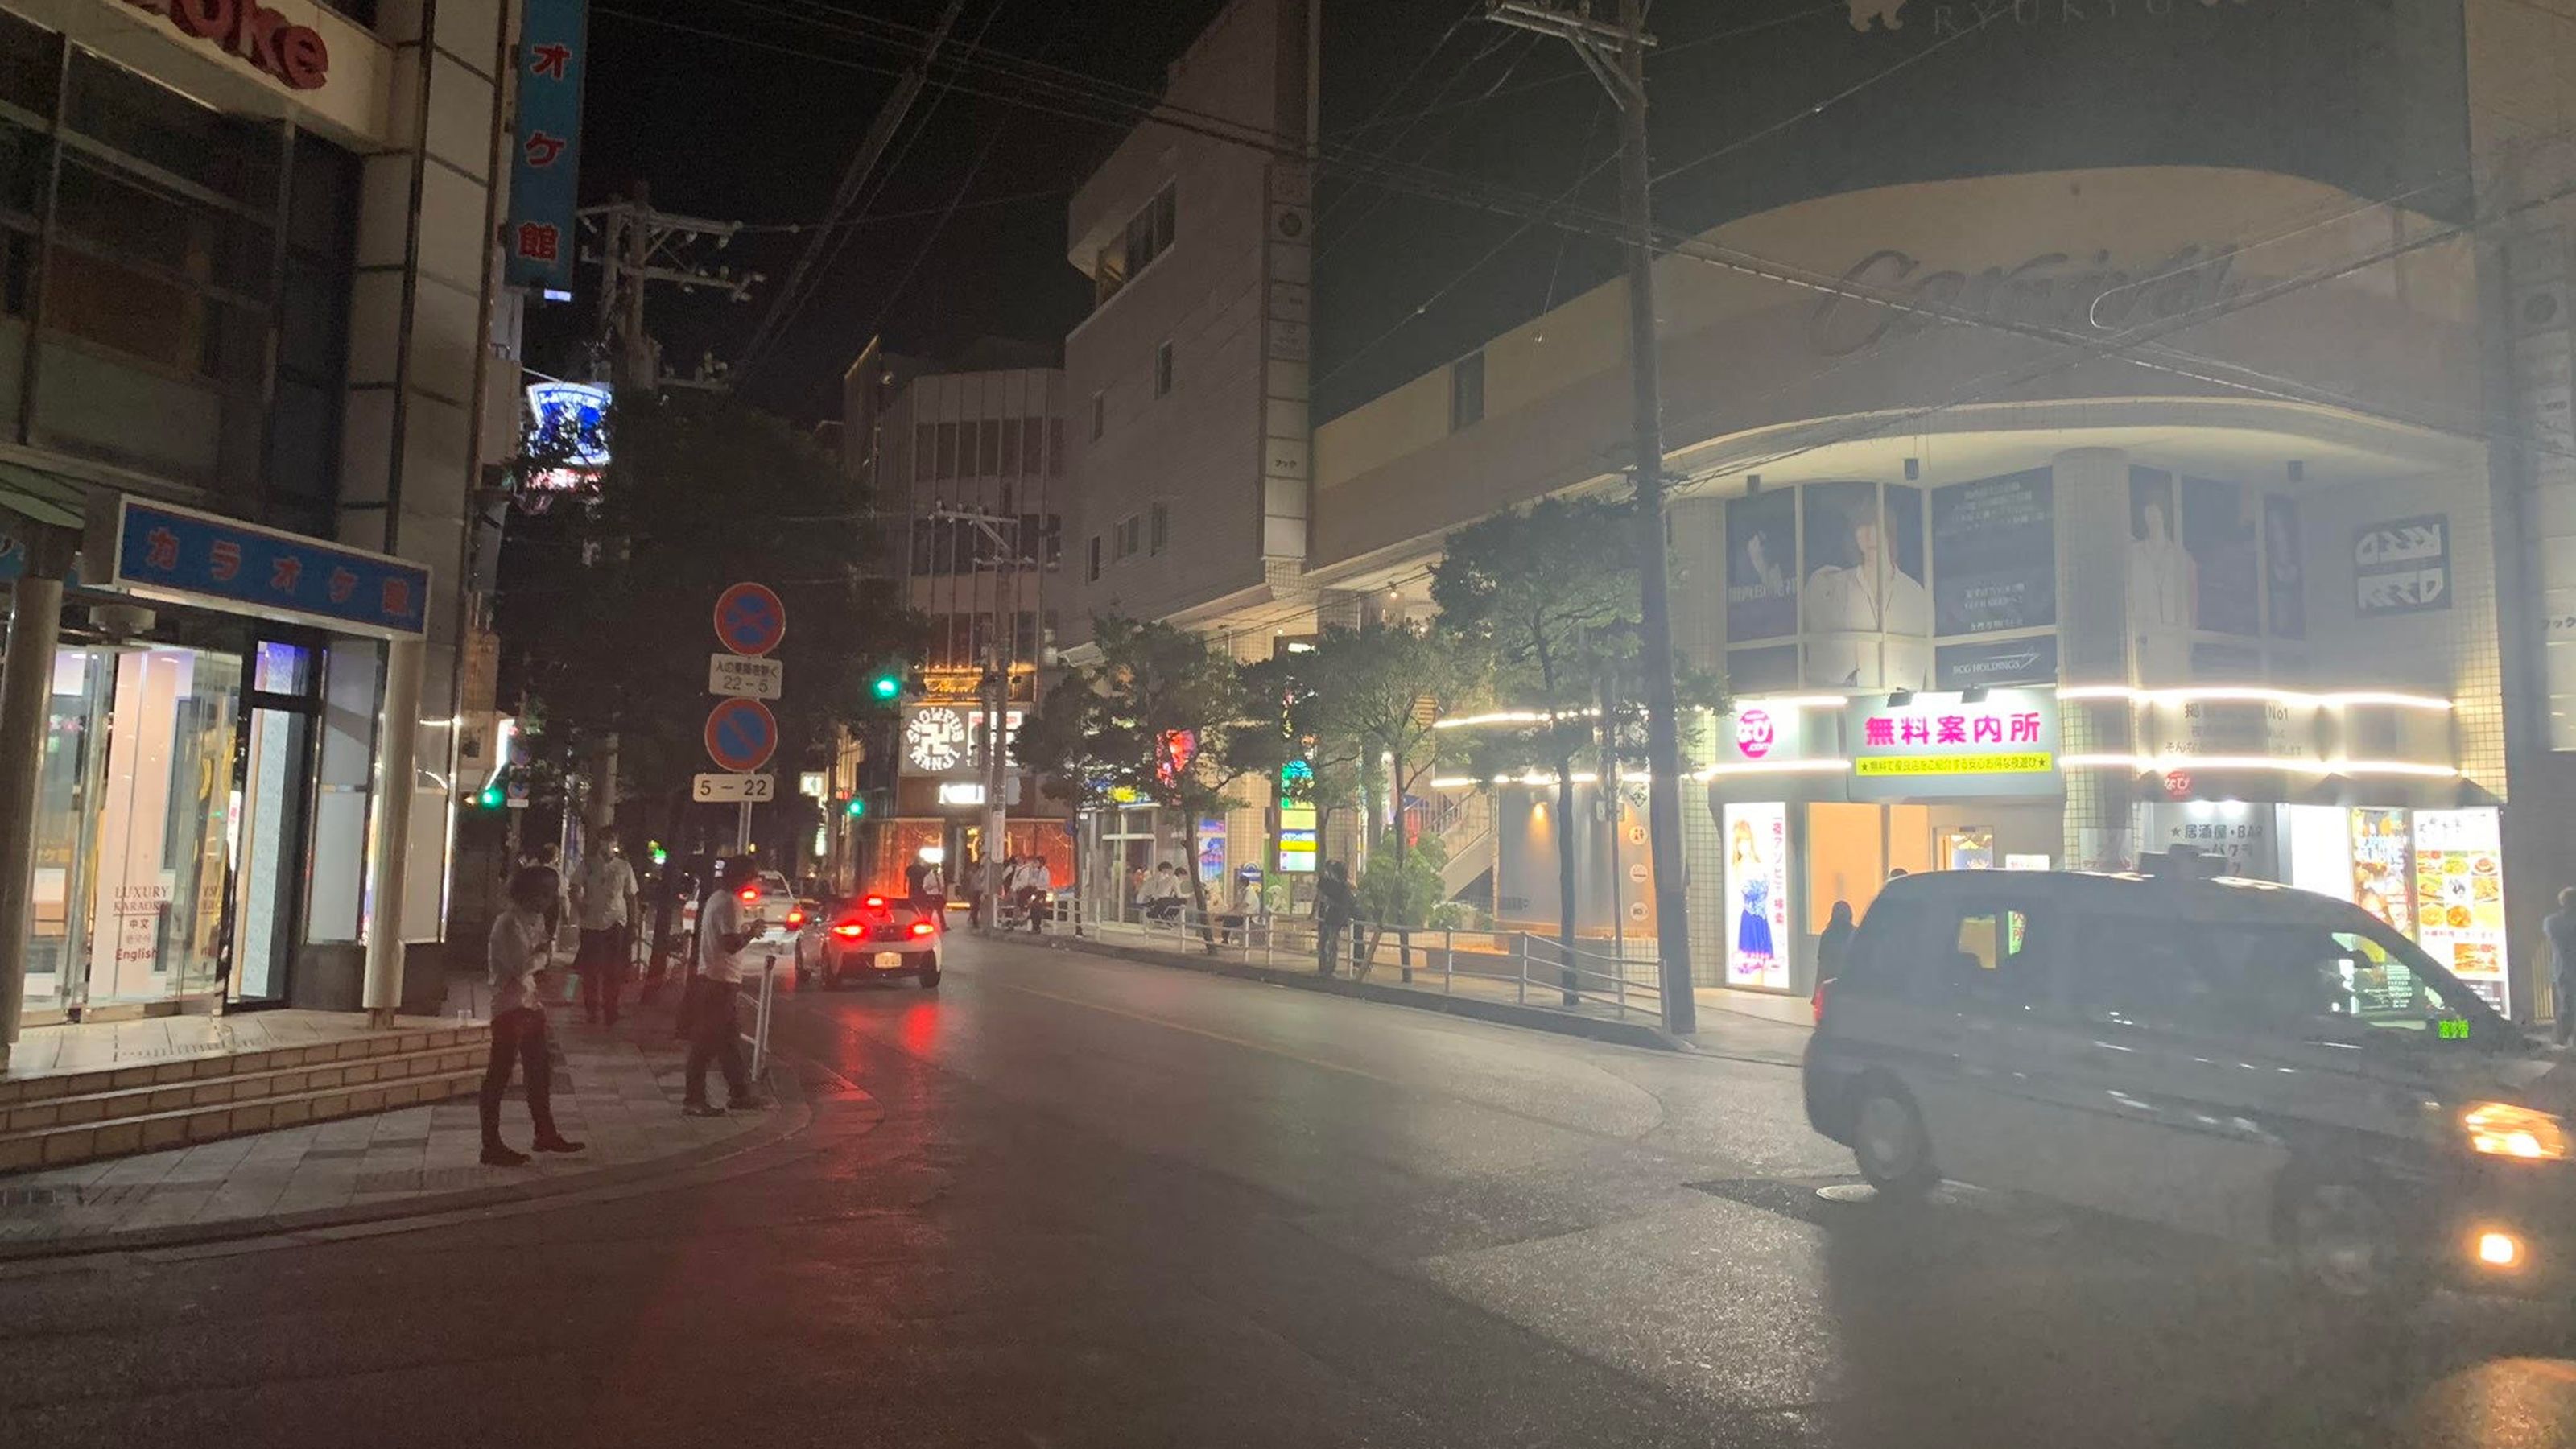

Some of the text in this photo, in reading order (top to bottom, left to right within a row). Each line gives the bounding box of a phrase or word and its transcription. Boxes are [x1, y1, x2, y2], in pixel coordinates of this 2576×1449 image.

[129, 0, 328, 90] oke
[906, 707, 964, 745] SHOWPUB
[1864, 712, 2041, 746] 無料案内所
[910, 748, 960, 771] MANJI
[115, 886, 170, 898] LUXURY
[129, 919, 150, 930] 中文
[115, 947, 159, 962] English
